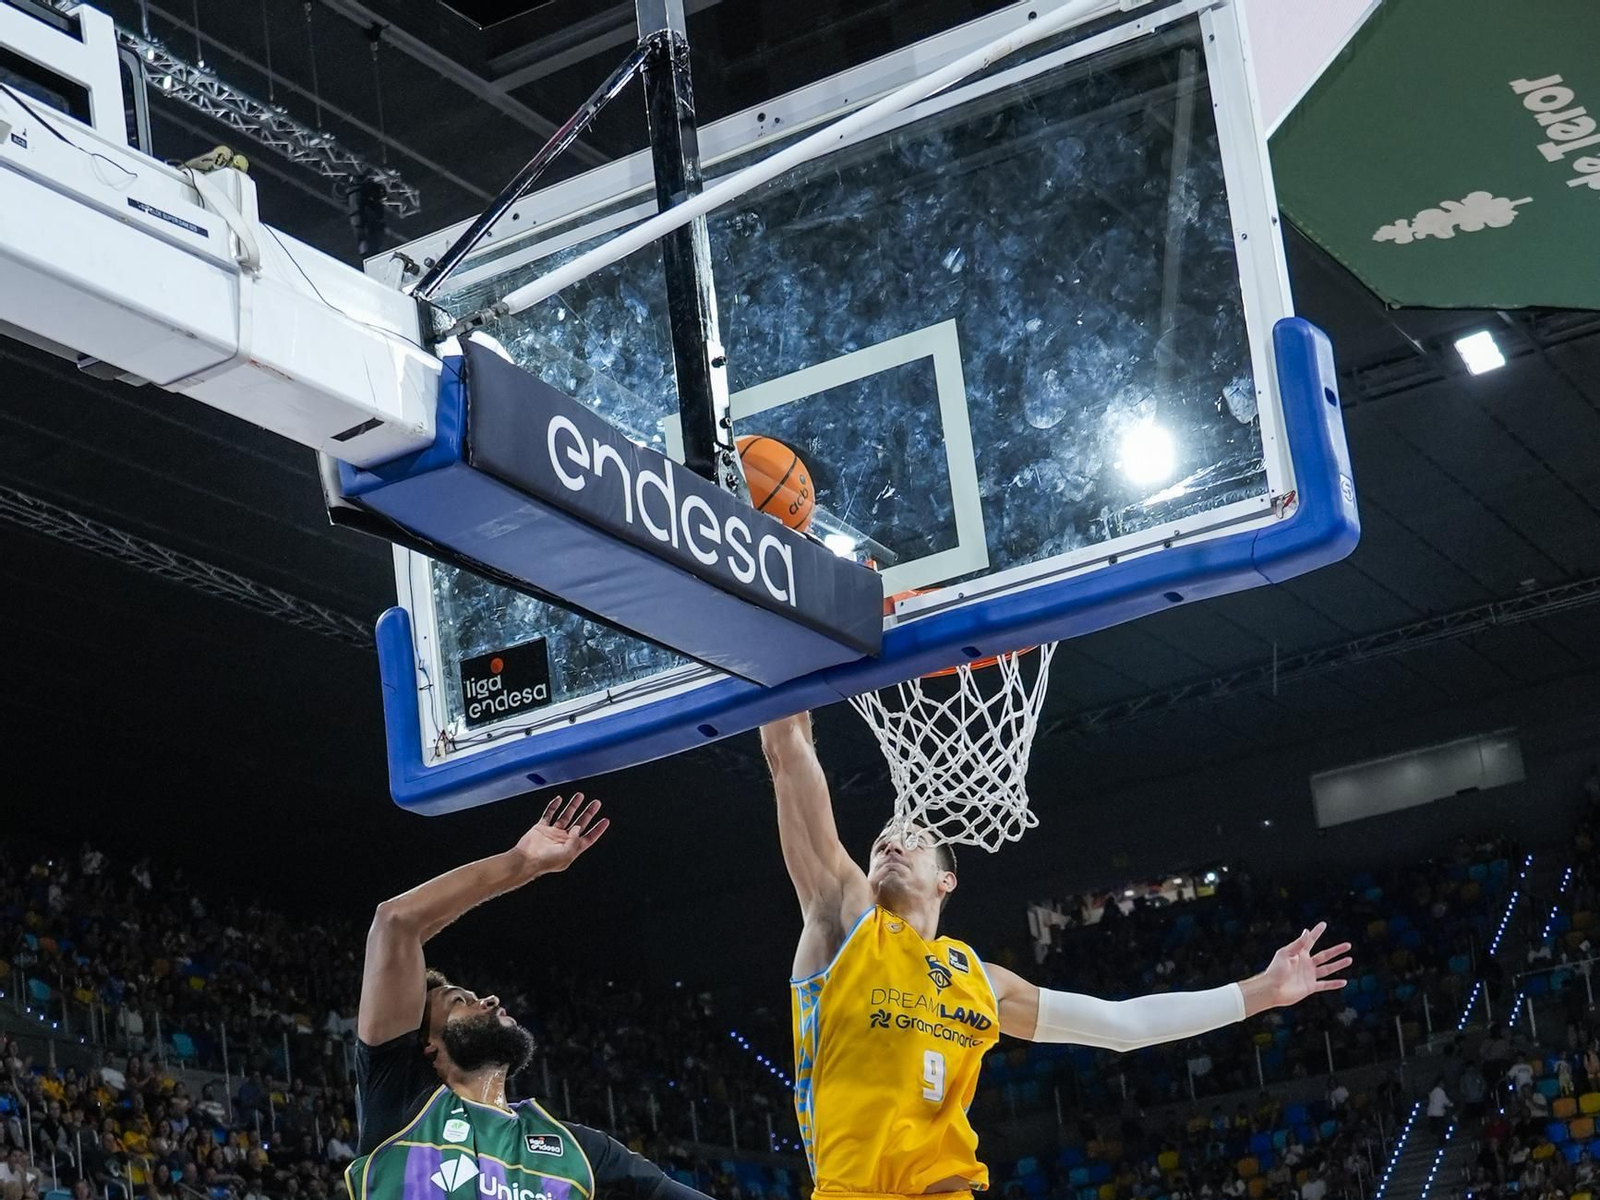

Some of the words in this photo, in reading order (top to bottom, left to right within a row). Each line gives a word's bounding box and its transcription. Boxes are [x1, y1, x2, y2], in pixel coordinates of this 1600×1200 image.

[1508, 74, 1600, 162] Teror
[547, 415, 797, 608] endesa
[789, 487, 809, 515] acb
[464, 674, 502, 699] liga
[468, 683, 547, 719] endesa
[871, 988, 991, 1031] DREAMLAND
[922, 1050, 945, 1102] 9
